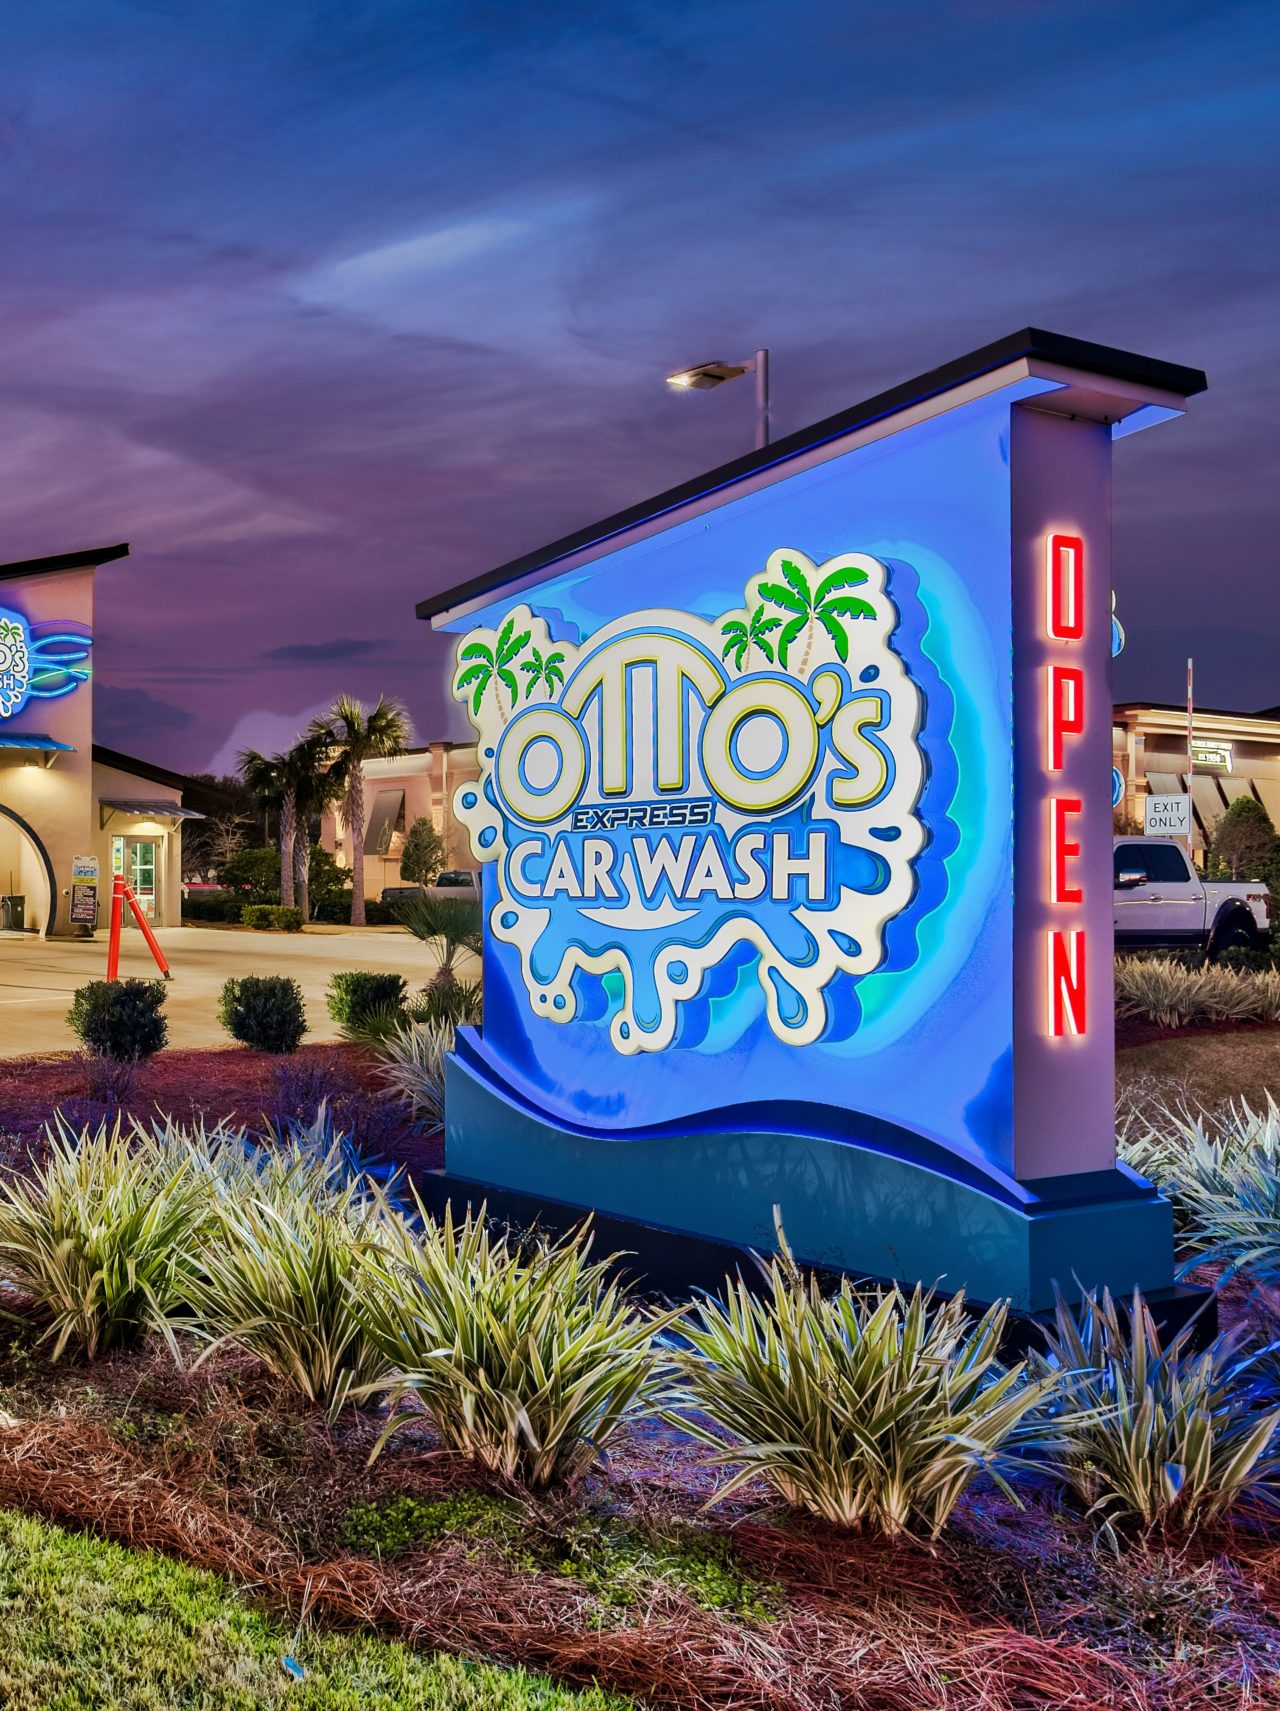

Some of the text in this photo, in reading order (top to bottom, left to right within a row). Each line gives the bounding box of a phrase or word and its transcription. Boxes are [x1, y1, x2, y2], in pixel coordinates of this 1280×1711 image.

[498, 634, 887, 822] OTTO'S
[1047, 534, 1086, 1037] OPEN
[1154, 802, 1182, 813] EXIT
[573, 803, 712, 831] EXPRESS
[1149, 817, 1186, 828] ONLY
[509, 832, 828, 901] CAR WASH
